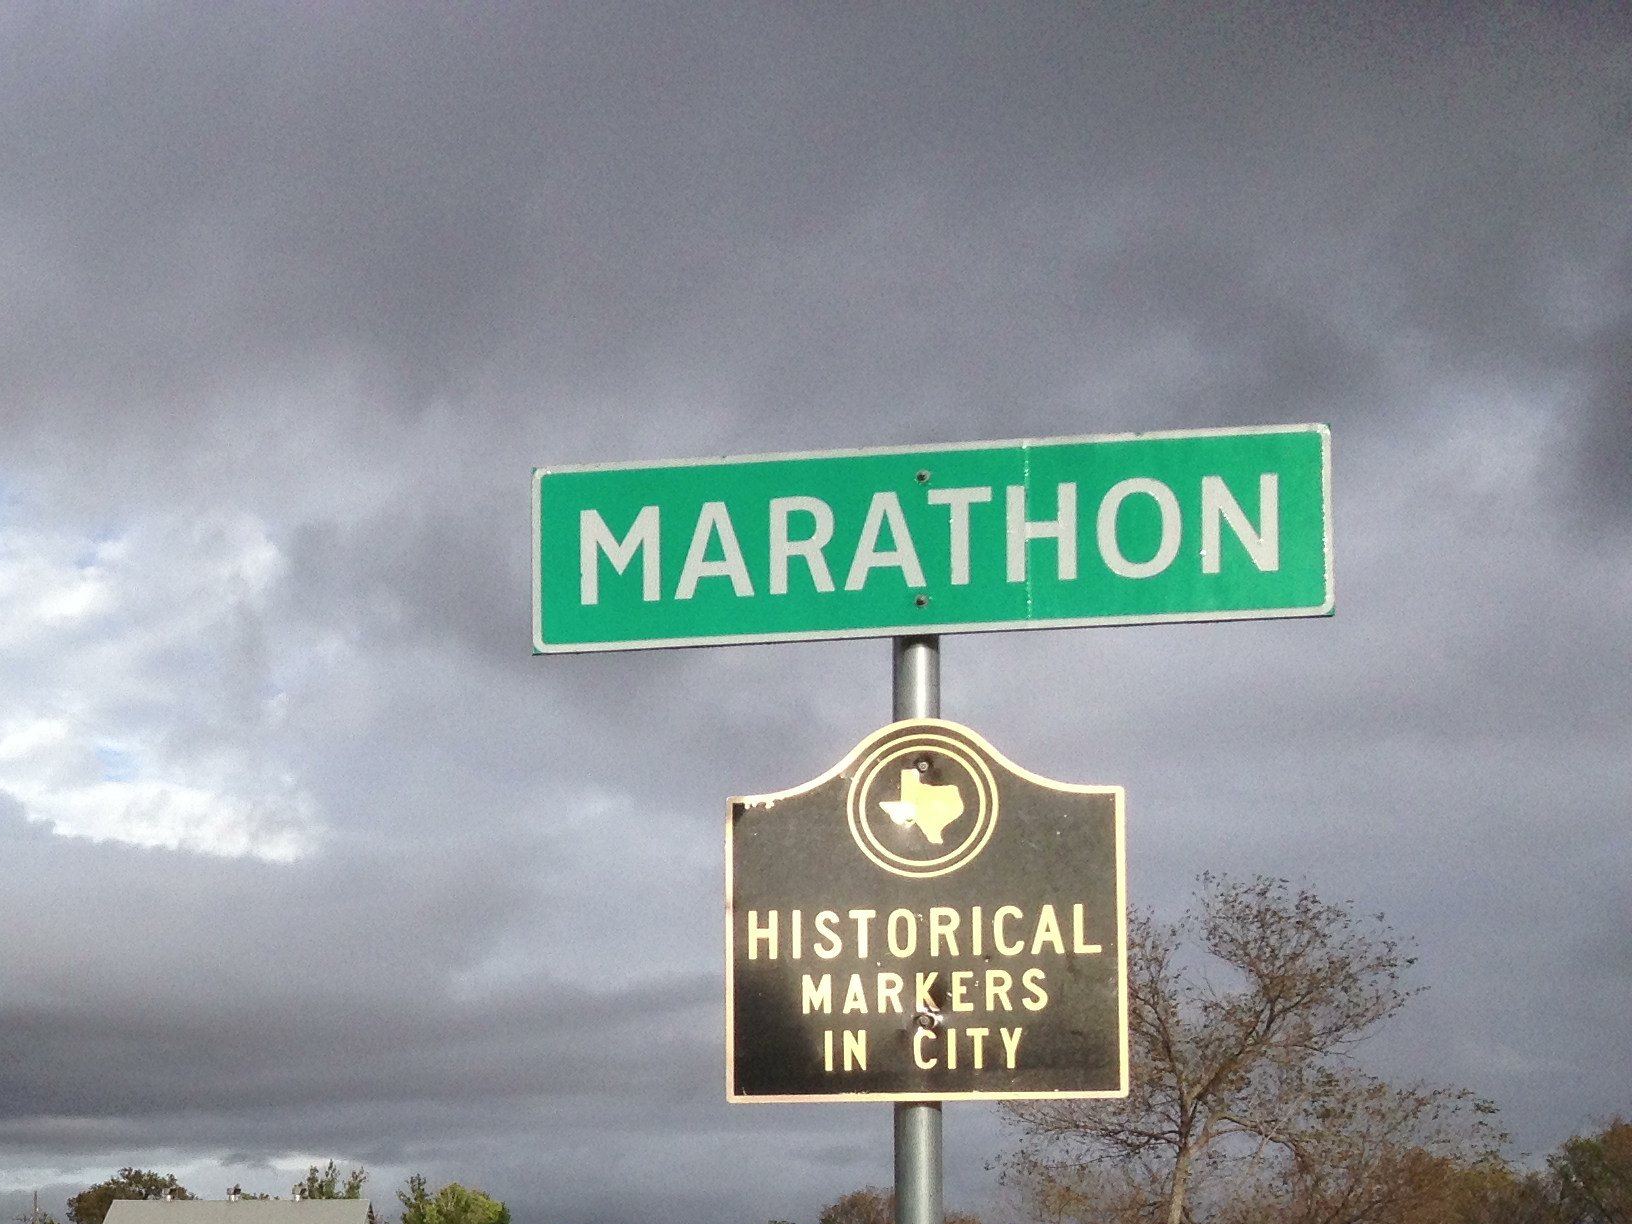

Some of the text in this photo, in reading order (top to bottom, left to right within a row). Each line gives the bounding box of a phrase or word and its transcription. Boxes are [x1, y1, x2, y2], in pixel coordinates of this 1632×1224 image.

[578, 472, 1280, 606] MARATHON
[747, 903, 1102, 960] HISTORICAL
[801, 967, 1049, 1015] MARKERS
[823, 1027, 1023, 1072] IN CITY
